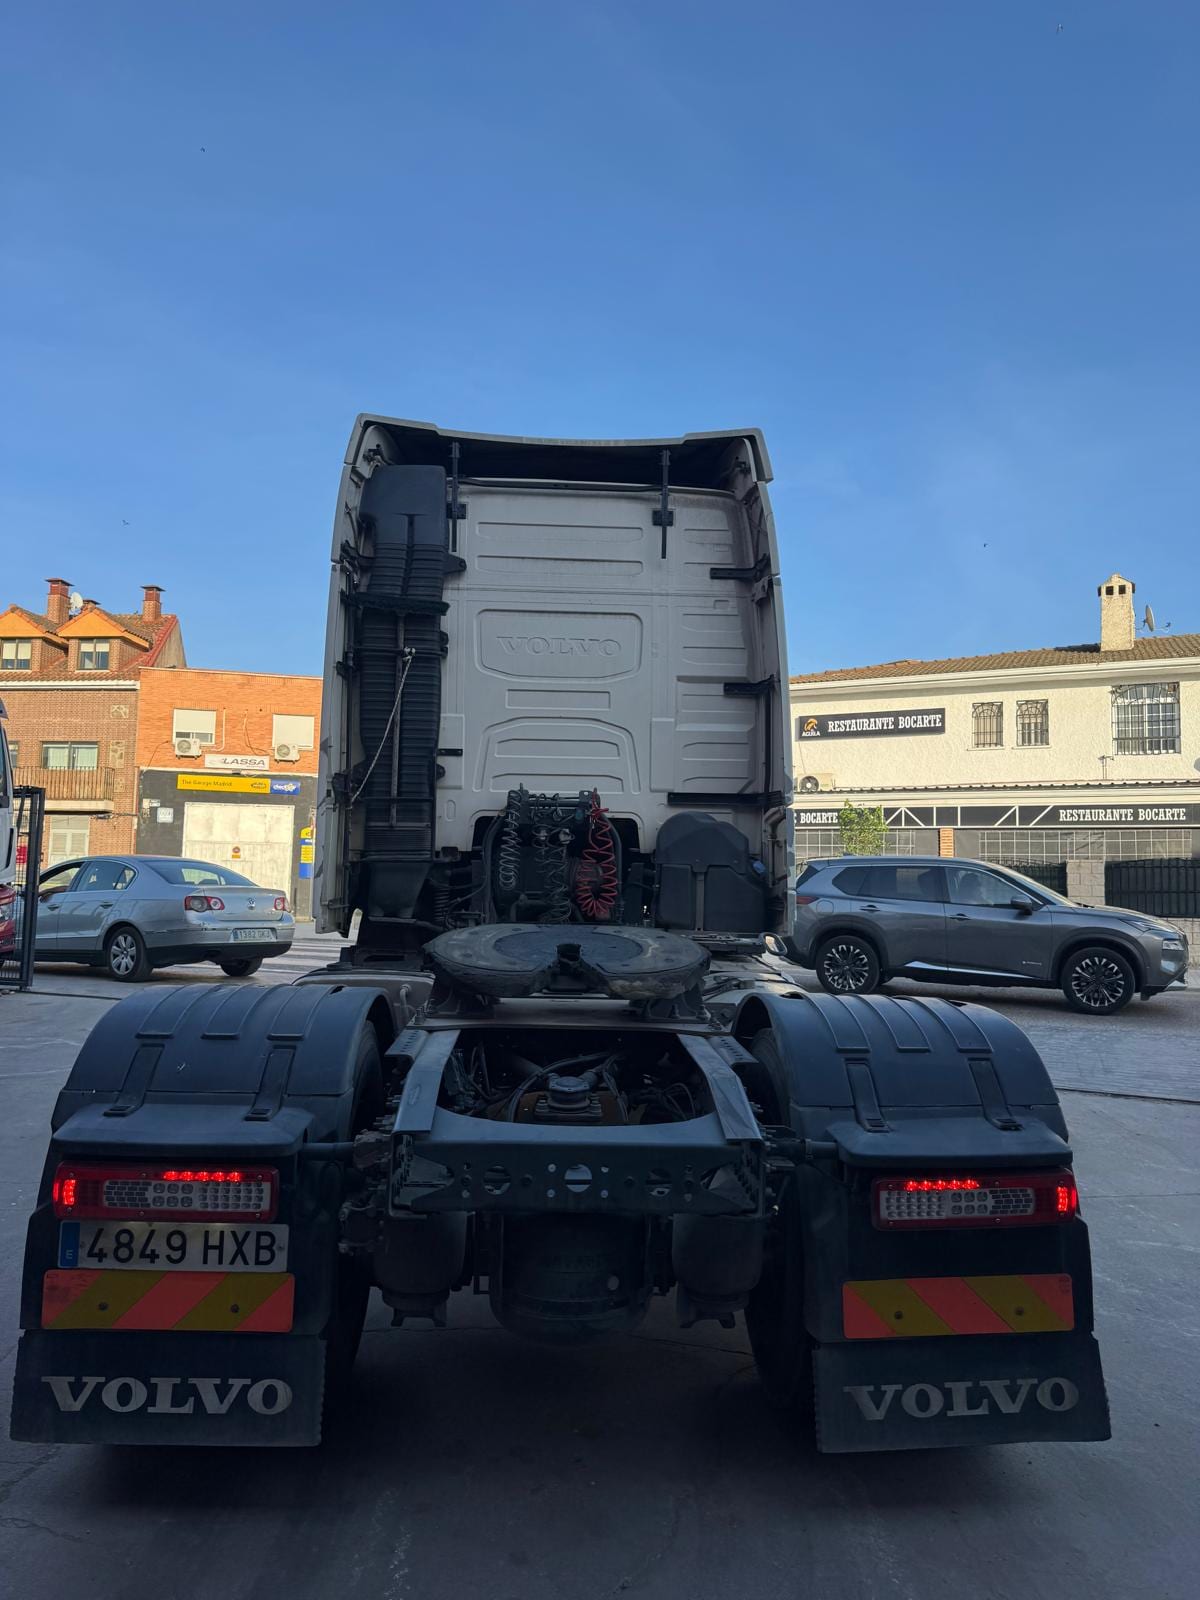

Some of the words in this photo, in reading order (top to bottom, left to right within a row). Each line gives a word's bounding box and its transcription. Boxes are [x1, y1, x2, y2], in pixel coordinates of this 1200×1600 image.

[496, 635, 622, 657] VOLVO
[827, 716, 895, 733] RESTAURANTE
[898, 714, 942, 729] BOCARTE
[223, 757, 265, 765] LASSA
[800, 812, 838, 824] BOCARTE
[1059, 808, 1134, 821] RESTAURANTE
[1138, 808, 1186, 820] BOCARTE
[65, 1250, 73, 1259] E
[87, 1228, 187, 1265] 4849
[202, 1230, 277, 1266] HXB
[41, 1375, 293, 1415] VOLVO
[842, 1377, 1080, 1421] VOLVO
